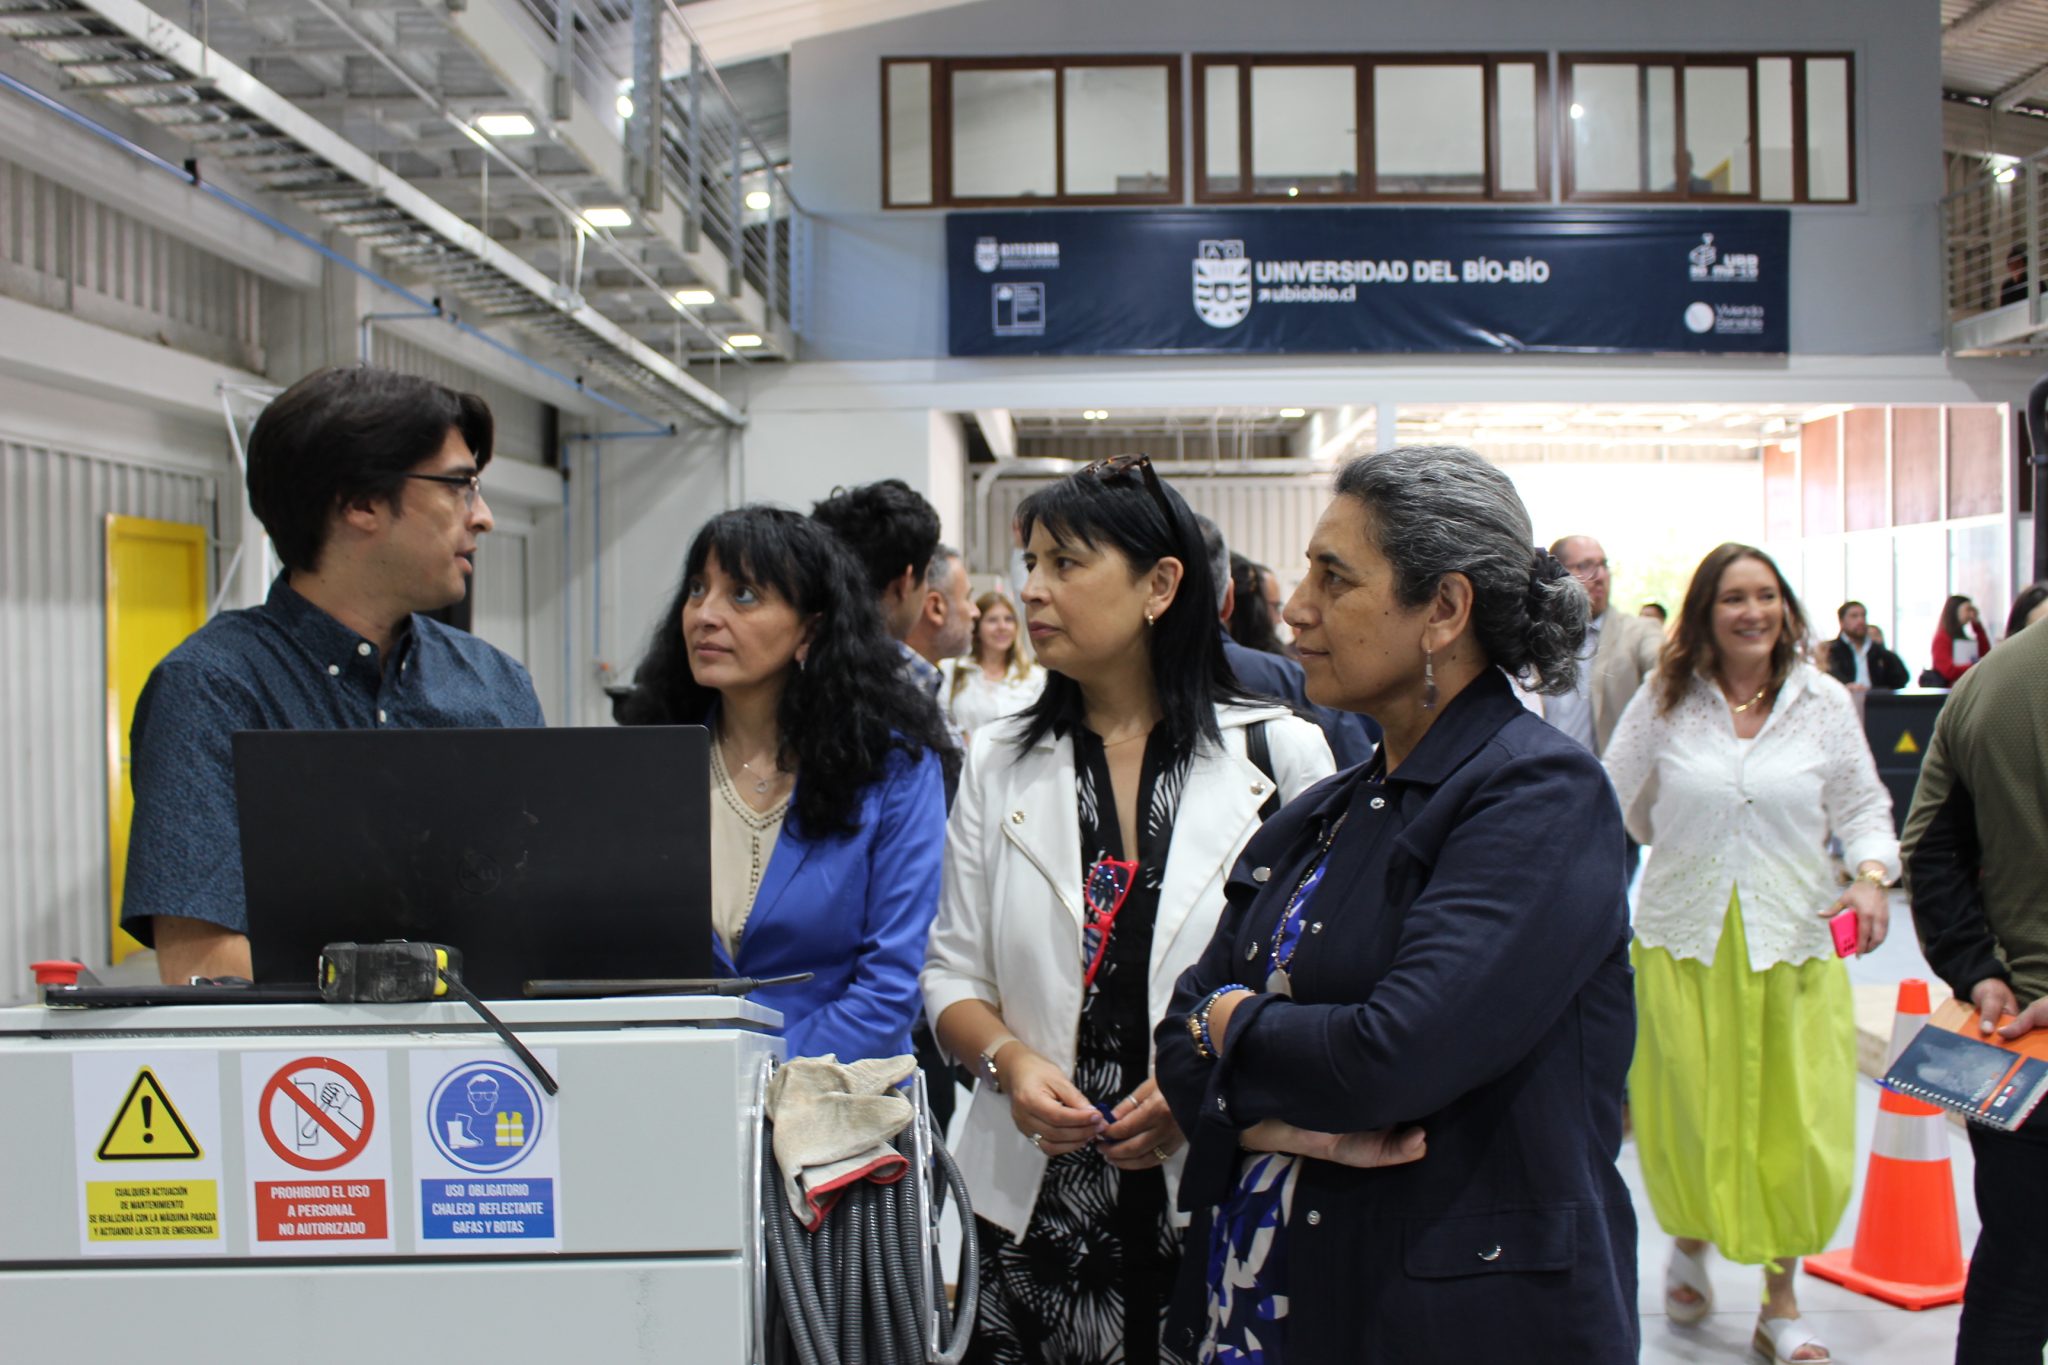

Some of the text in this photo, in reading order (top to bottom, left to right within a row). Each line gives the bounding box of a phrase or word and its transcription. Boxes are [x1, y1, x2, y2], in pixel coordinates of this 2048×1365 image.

[1255, 256, 1550, 283] UNIVERSIDAD DEL BÍO-BÍO
[115, 1185, 188, 1197] CUALQUIER ACTUACIÓN
[270, 1185, 370, 1199] PROHIBIDO EL USO
[445, 1183, 529, 1197] USO OBLIGATORIO
[120, 1199, 184, 1209] DE MANTENIMIENTO
[287, 1203, 356, 1217] A PERSONAL
[432, 1202, 544, 1215] CHALECO REFLECTANTE
[89, 1214, 97, 1223] SE
[136, 1213, 148, 1222] CON
[150, 1213, 158, 1222] LA
[190, 1212, 216, 1221] PARADA
[94, 1225, 213, 1236] Y ACTUANDO LA SETA DE EMERGENCIA
[278, 1222, 366, 1236] NO AUTORIZADO
[452, 1220, 525, 1233] GAFAS Y BOTAS
